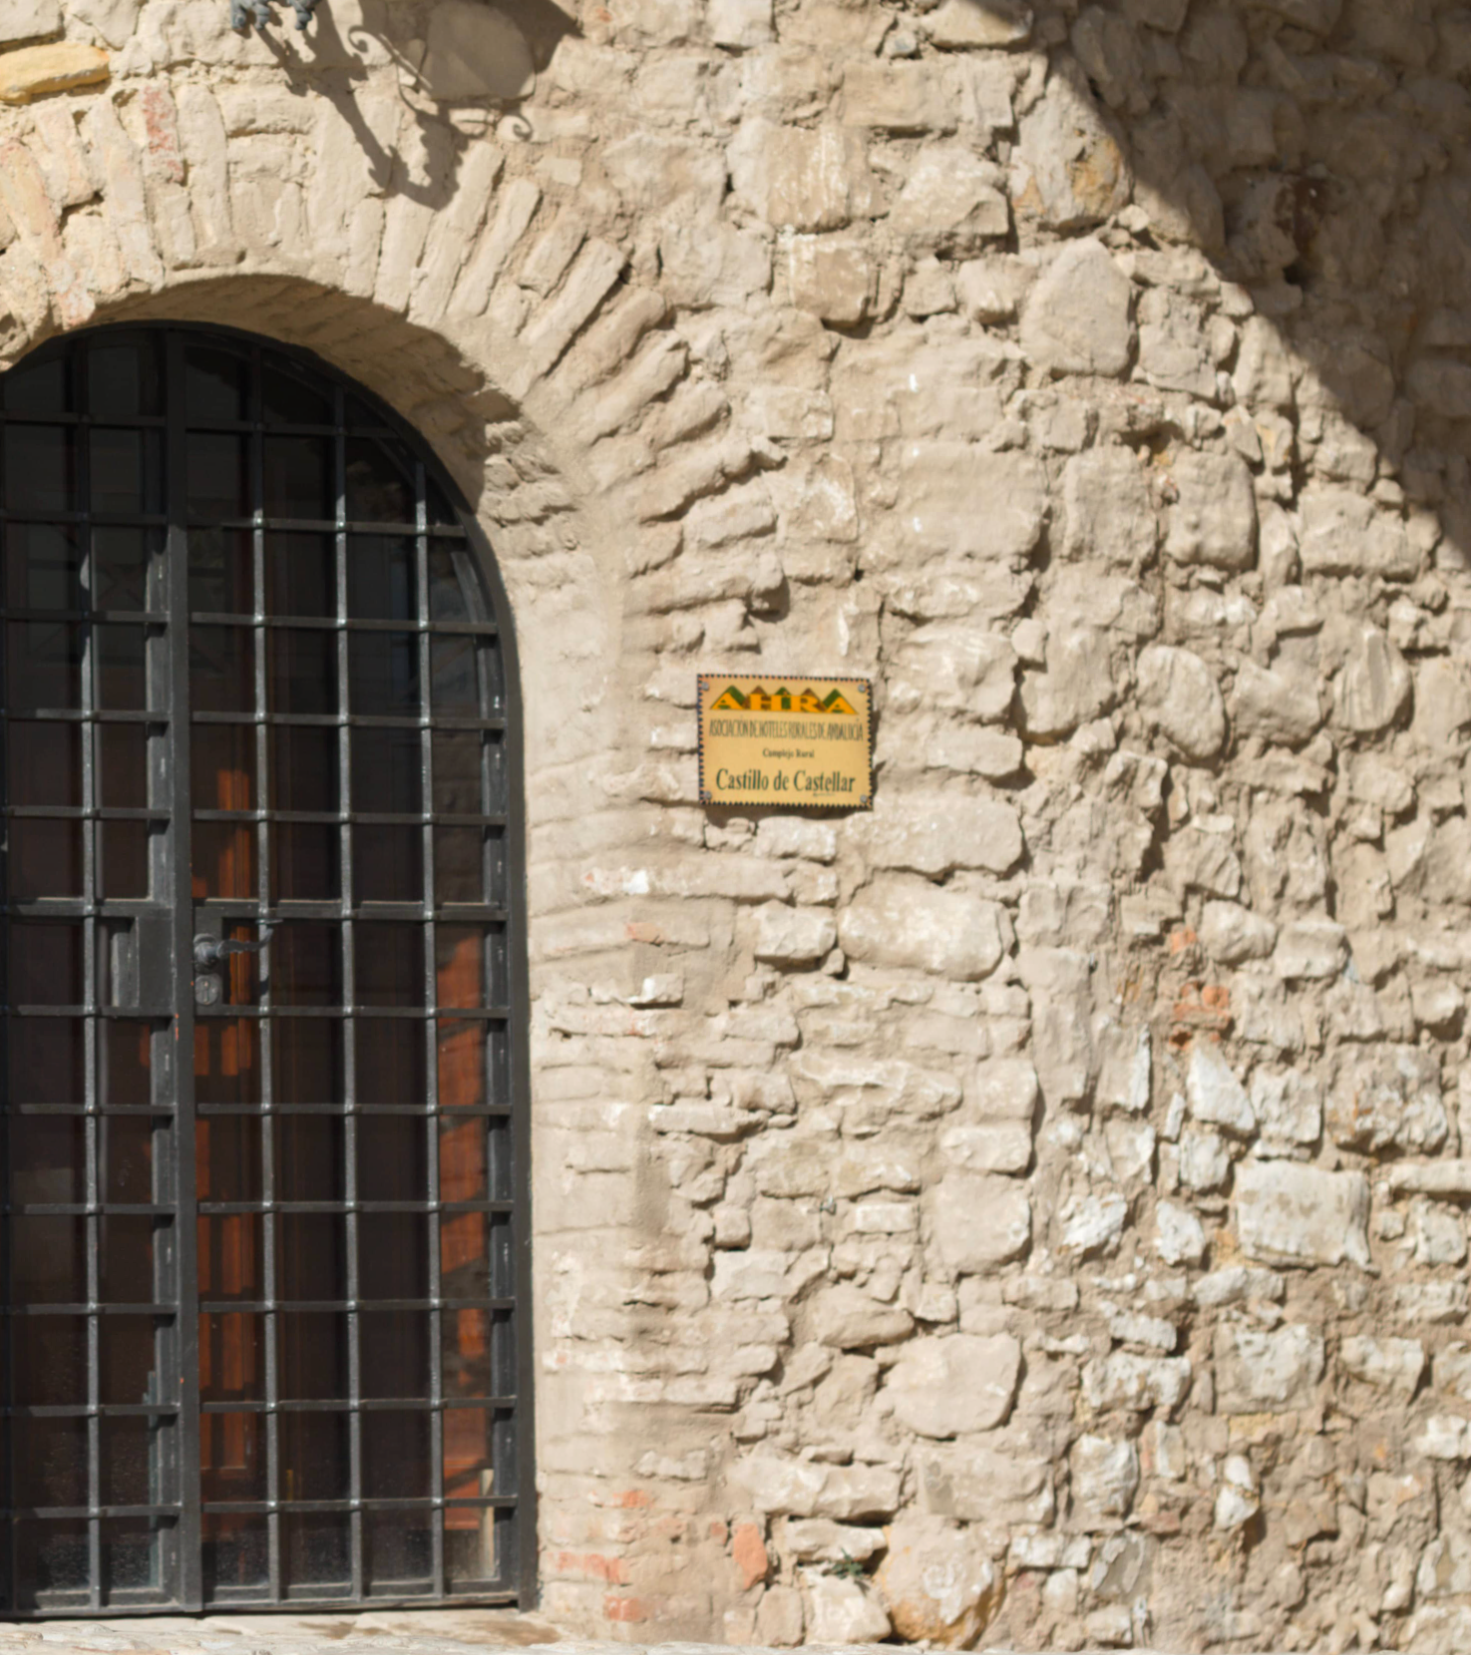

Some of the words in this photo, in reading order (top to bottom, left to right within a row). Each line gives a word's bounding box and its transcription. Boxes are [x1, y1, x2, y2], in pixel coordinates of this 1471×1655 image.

[709, 715, 748, 738] ASOCIACIÓN
[759, 720, 788, 740] HOTELES
[789, 720, 817, 741] RURALES
[827, 717, 864, 742] ANDALUCÍA
[762, 748, 794, 760] Complejo
[796, 748, 815, 759] Rural
[716, 767, 769, 791] Castillo
[773, 769, 790, 791] de
[793, 769, 856, 793] Castellar
